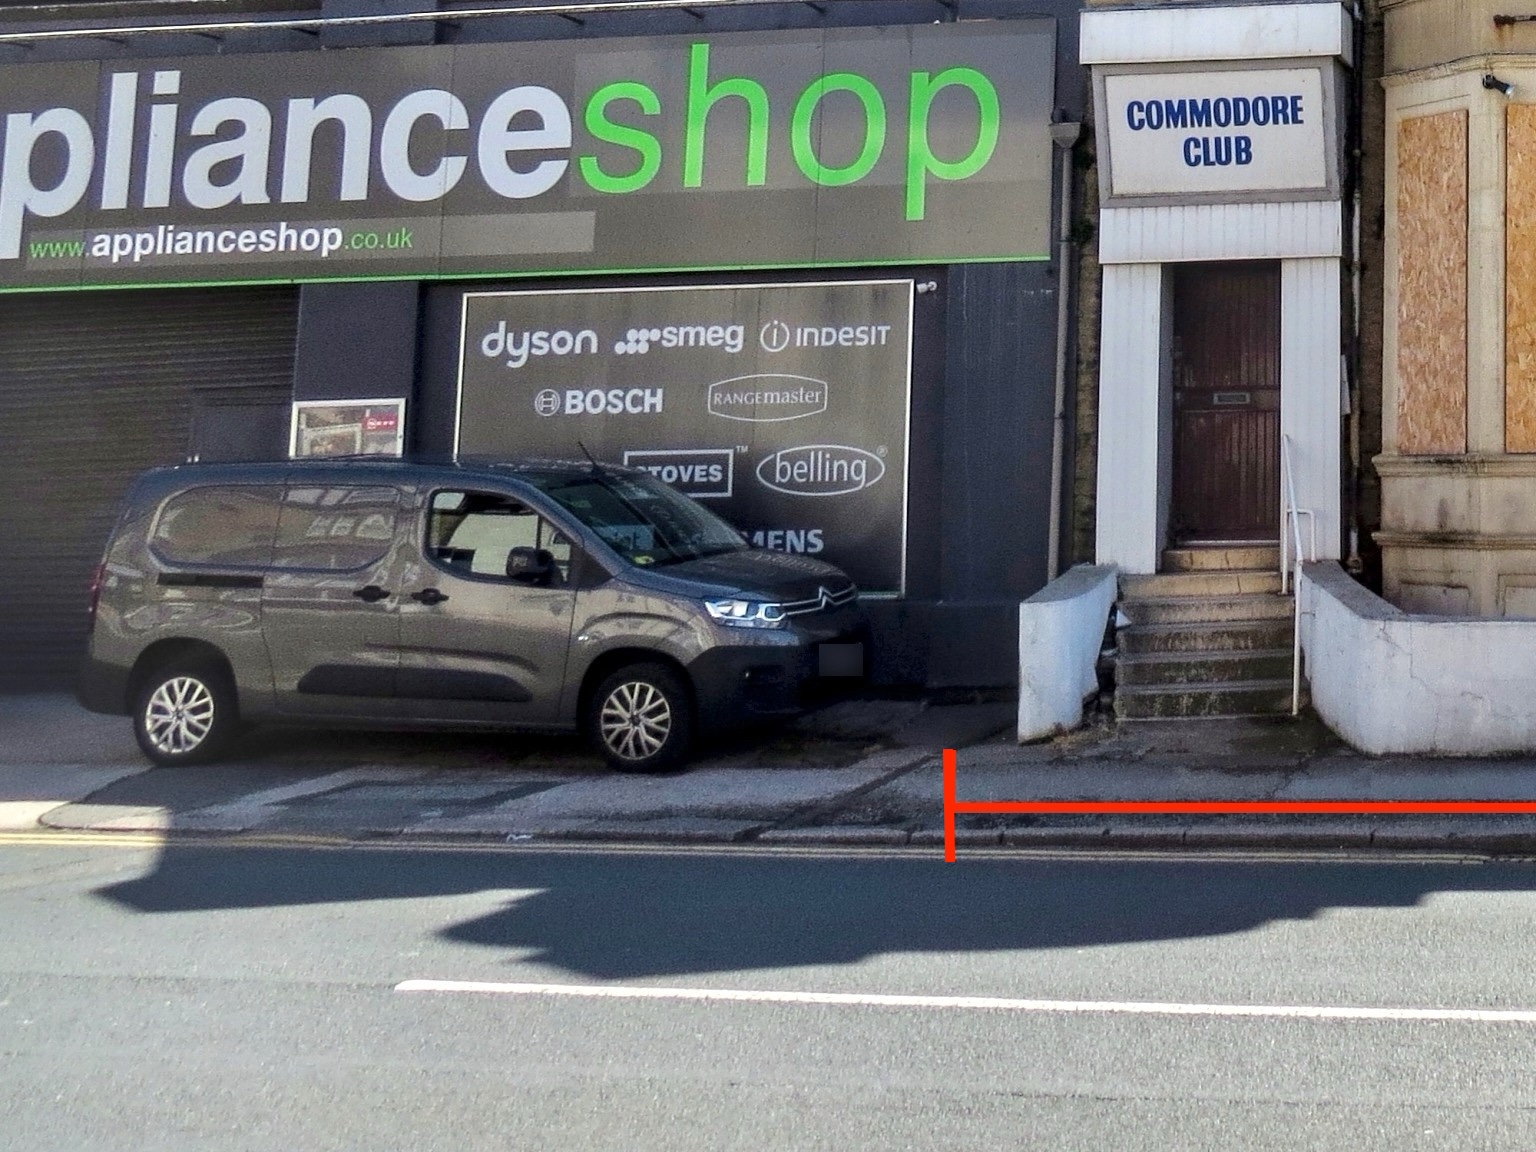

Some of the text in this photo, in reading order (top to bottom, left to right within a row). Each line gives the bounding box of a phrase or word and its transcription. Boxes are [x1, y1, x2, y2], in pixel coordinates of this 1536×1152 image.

[1126, 95, 1304, 131] COMMODORE
[1183, 135, 1253, 167] CLUB
[29, 222, 413, 263] www.applianceshop.co.uk
[481, 320, 598, 368] dyson
[661, 325, 744, 353] smeg
[564, 388, 663, 415] BOSCH
[713, 386, 823, 406] RANGEmaster
[637, 464, 723, 483] TOVES
[775, 450, 867, 488] belling
